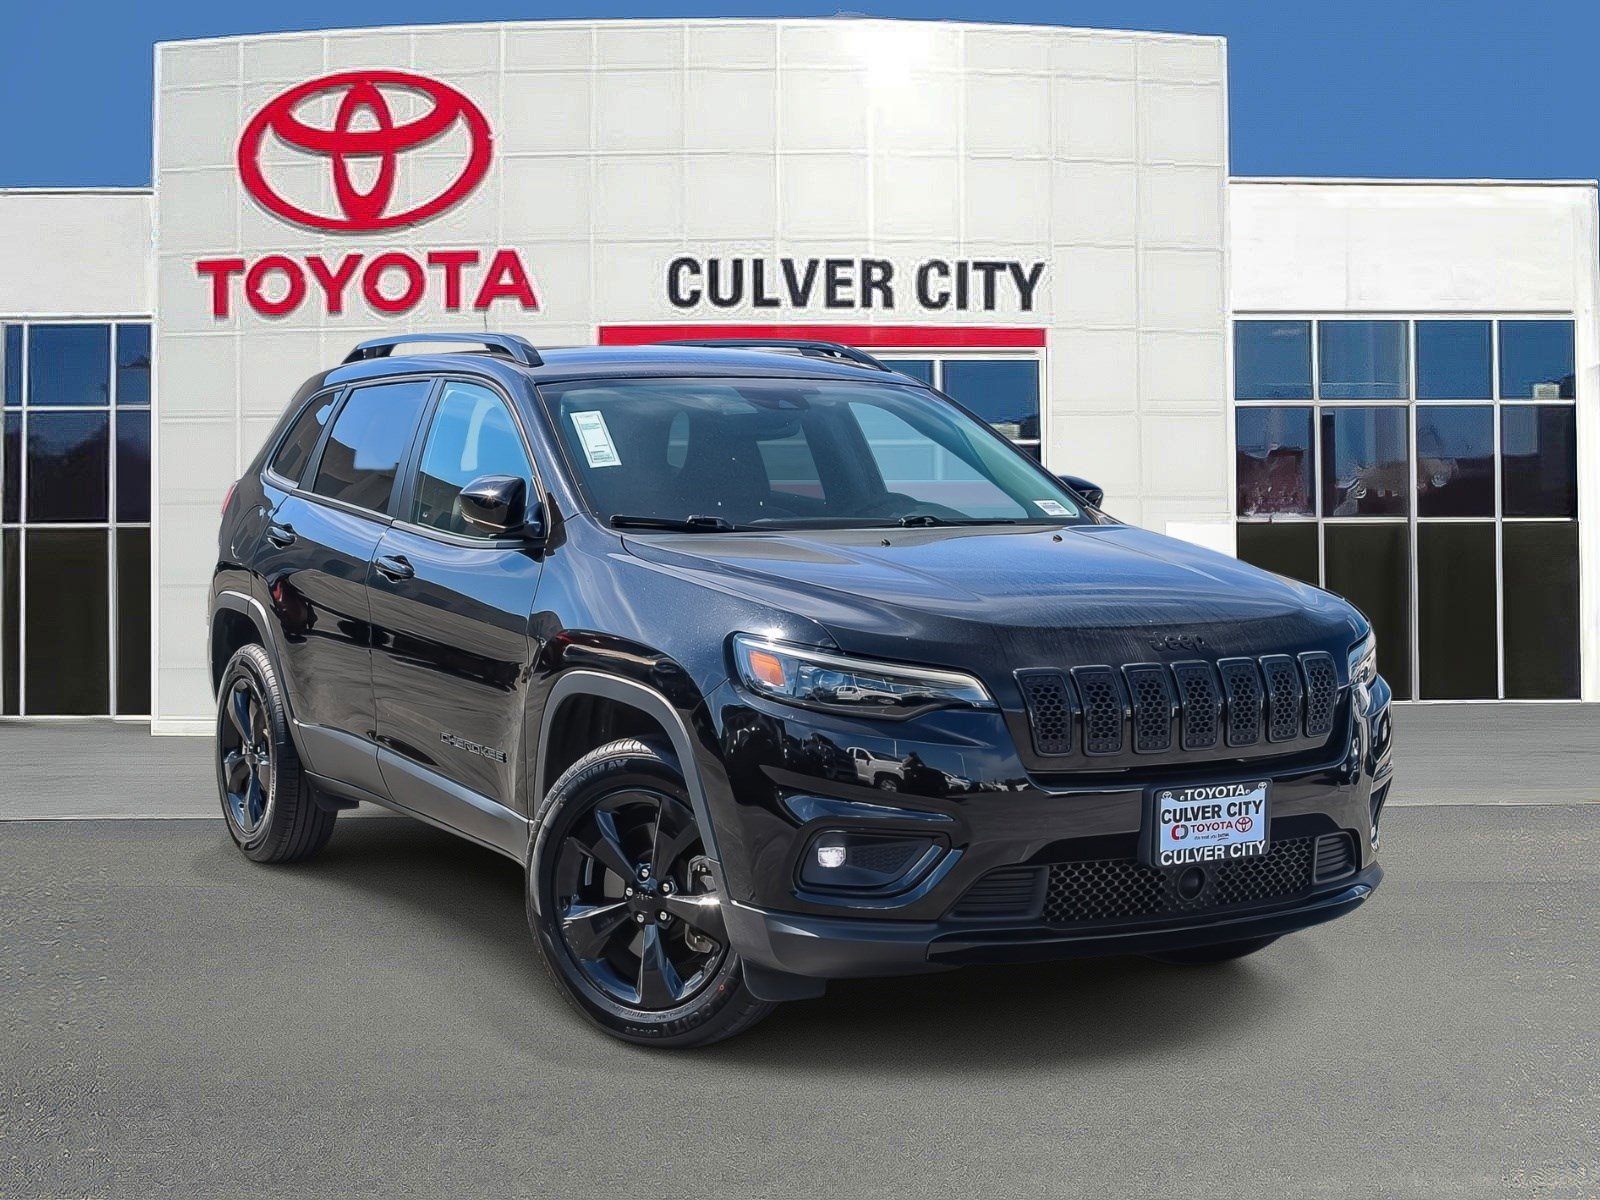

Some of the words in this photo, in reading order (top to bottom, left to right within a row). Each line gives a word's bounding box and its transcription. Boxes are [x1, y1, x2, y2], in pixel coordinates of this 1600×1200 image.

[195, 250, 539, 318] TOYOTA
[667, 257, 895, 309] CULVER
[915, 259, 1045, 311] CITY
[1185, 784, 1245, 801] TOYOTA
[1161, 804, 1222, 824] CULVER
[1227, 800, 1263, 817] CITY
[1191, 821, 1233, 833] TOYOTA
[1160, 845, 1225, 866] CULVER
[1230, 840, 1266, 858] CITY
